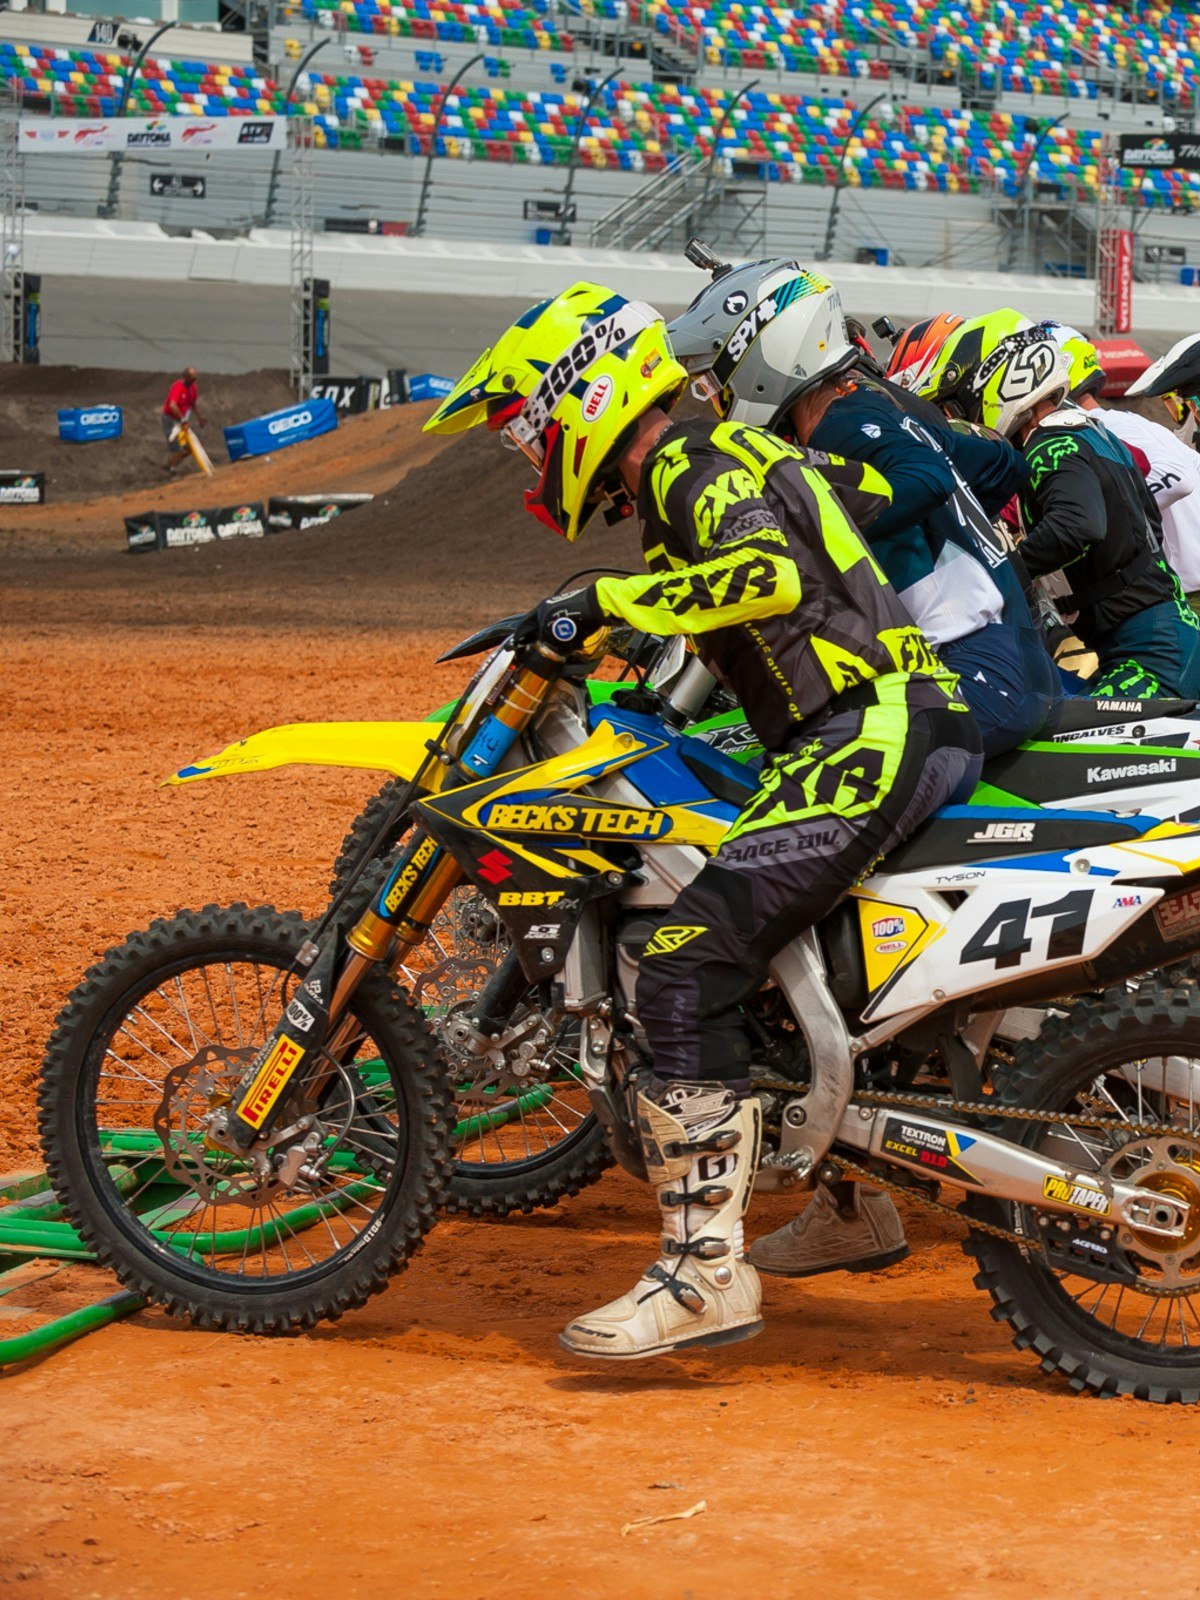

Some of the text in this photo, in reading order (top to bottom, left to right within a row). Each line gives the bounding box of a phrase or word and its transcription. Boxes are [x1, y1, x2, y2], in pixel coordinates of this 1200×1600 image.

[585, 383, 609, 417] BELL
[80, 410, 120, 427] GEICO
[267, 410, 313, 435] GEICO
[1096, 701, 1142, 713] YAMAHA
[1053, 725, 1126, 744] ONCALVES
[1087, 757, 1178, 785] Kawasaki
[486, 804, 664, 836] BECK'S TECH
[973, 822, 1036, 841] JGR
[724, 838, 790, 864] RACE
[383, 834, 440, 914] BECK'S TECH
[935, 870, 987, 884] TYSON
[498, 890, 566, 907] BBT
[1112, 894, 1143, 910] AMA
[872, 917, 905, 938] 100%
[959, 888, 1096, 971] 41
[879, 941, 906, 953] BELL
[241, 1039, 298, 1124] PIRELLI
[900, 1125, 947, 1147] TEXTRON
[884, 1139, 919, 1157] EXCEL
